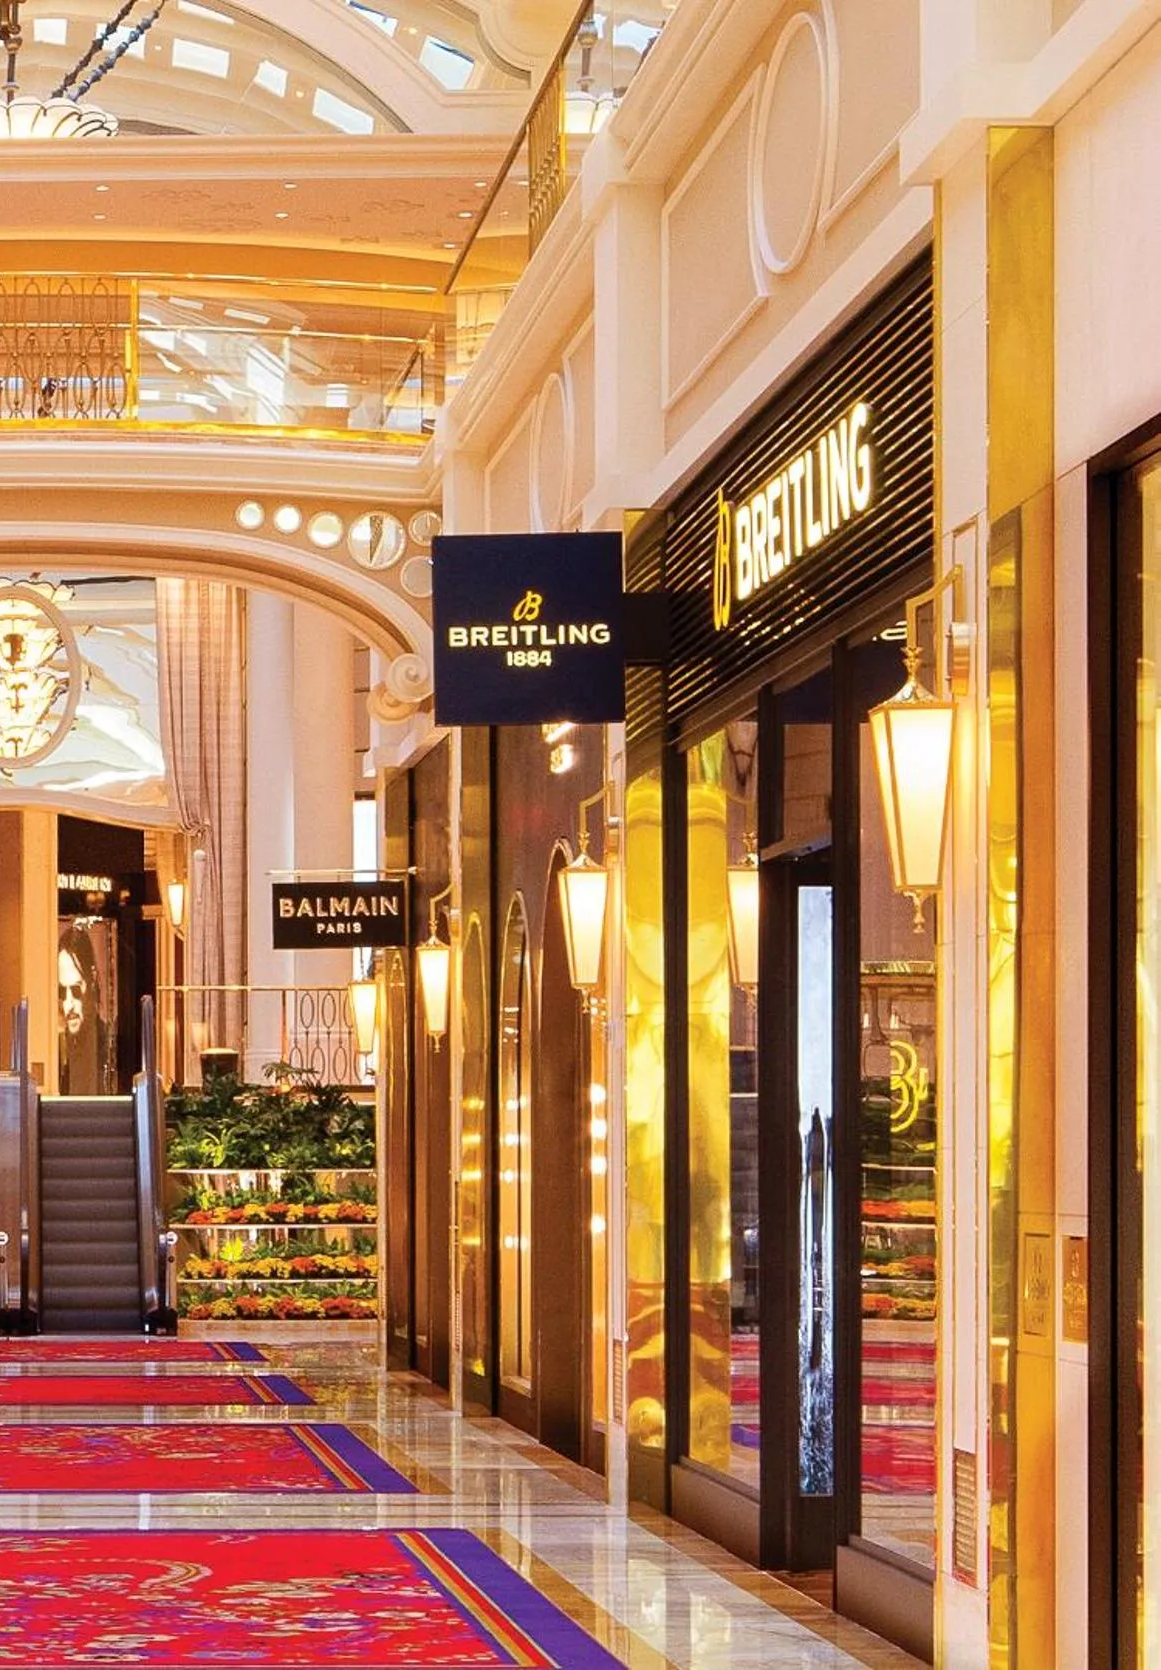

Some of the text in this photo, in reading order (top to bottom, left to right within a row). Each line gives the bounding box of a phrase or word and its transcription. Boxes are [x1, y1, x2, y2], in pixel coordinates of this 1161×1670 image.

[736, 402, 871, 601] BREITLING
[448, 623, 611, 648] BREITLING
[506, 650, 553, 667] 1884
[279, 896, 399, 918] BALMAIN
[316, 921, 363, 934] PARIS
